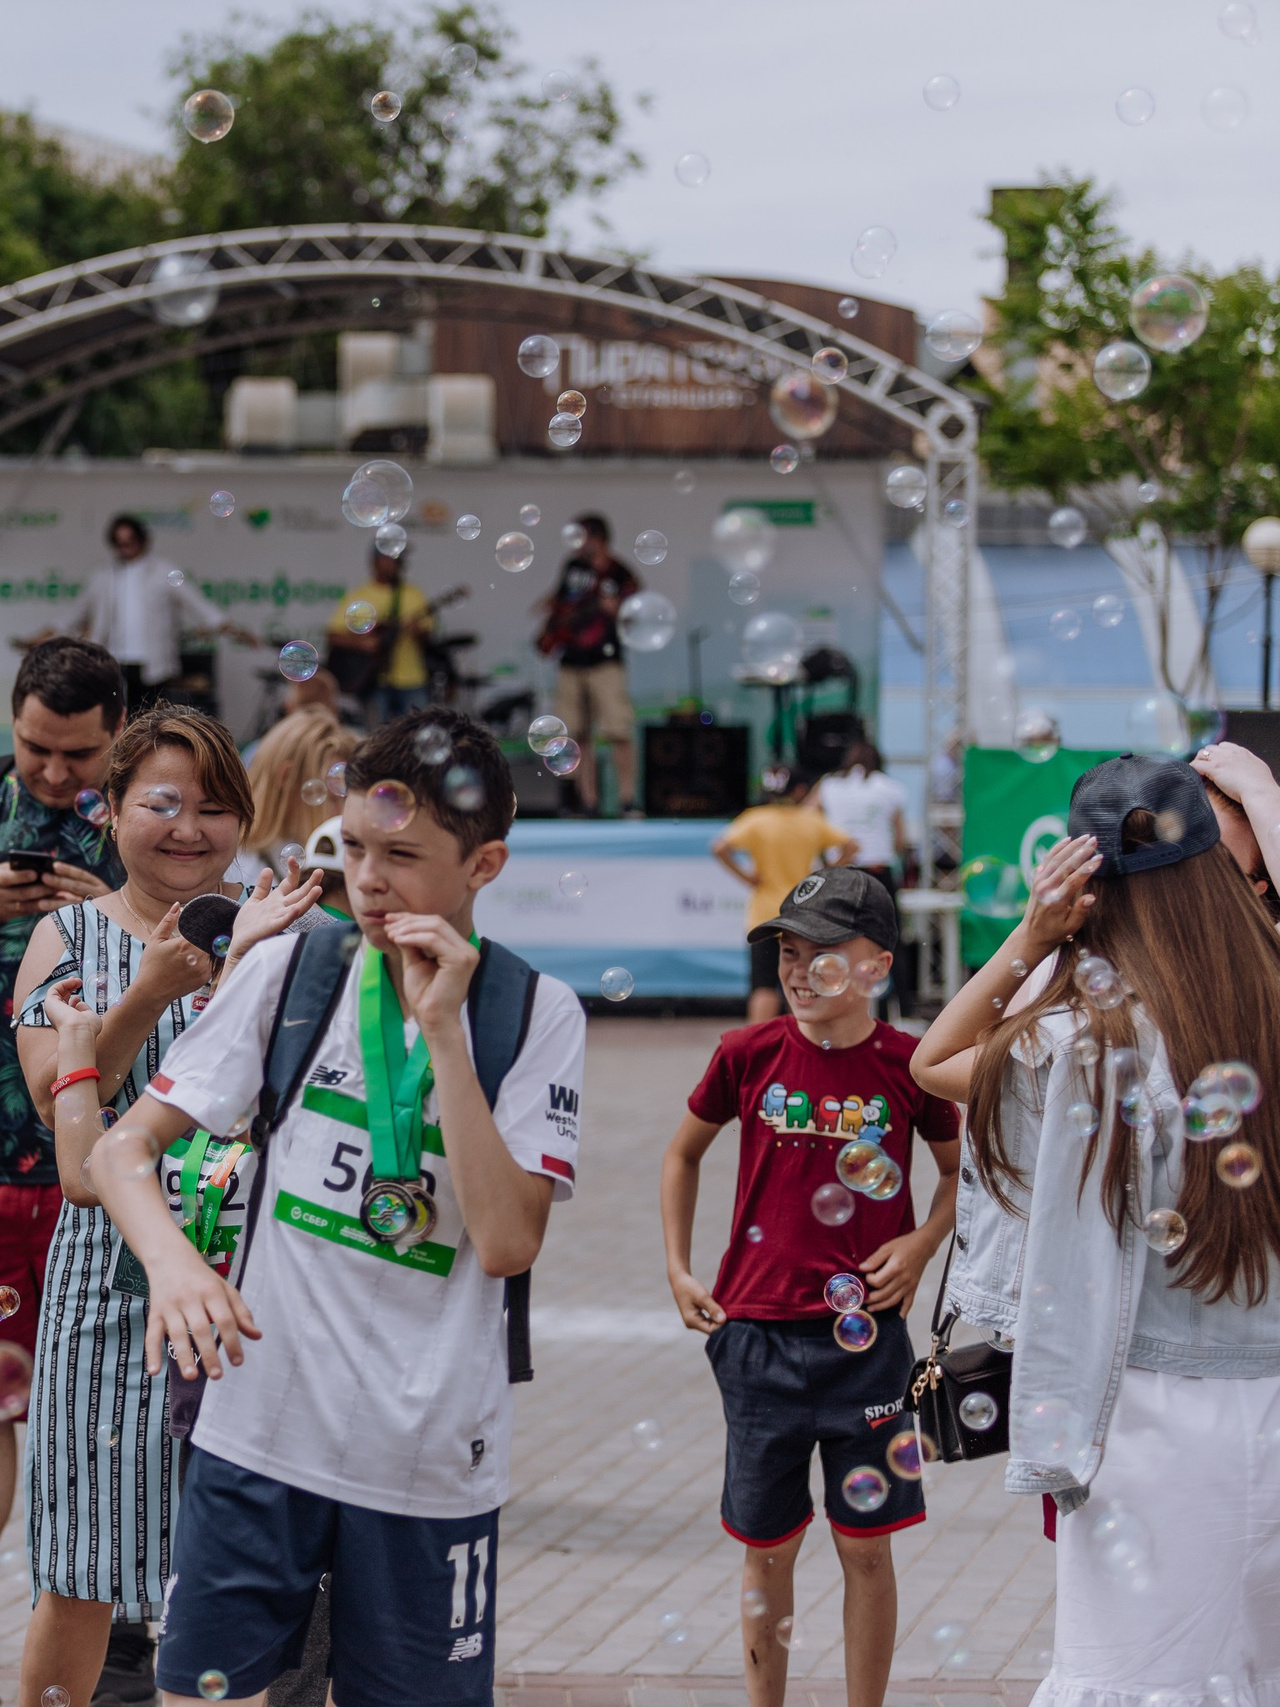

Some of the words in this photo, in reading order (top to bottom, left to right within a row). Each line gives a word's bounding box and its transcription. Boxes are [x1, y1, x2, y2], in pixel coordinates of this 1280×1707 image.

[302, 1212, 328, 1228] СБЕР
[120, 1316, 128, 1338] LOOKING
[70, 1343, 78, 1364] BETTER
[94, 1340, 102, 1364] LOOKING
[67, 1365, 75, 1390] LOOKING
[92, 1365, 100, 1379] THAT
[68, 1525, 76, 1550] LOOKING
[446, 1536, 489, 1629] 11
